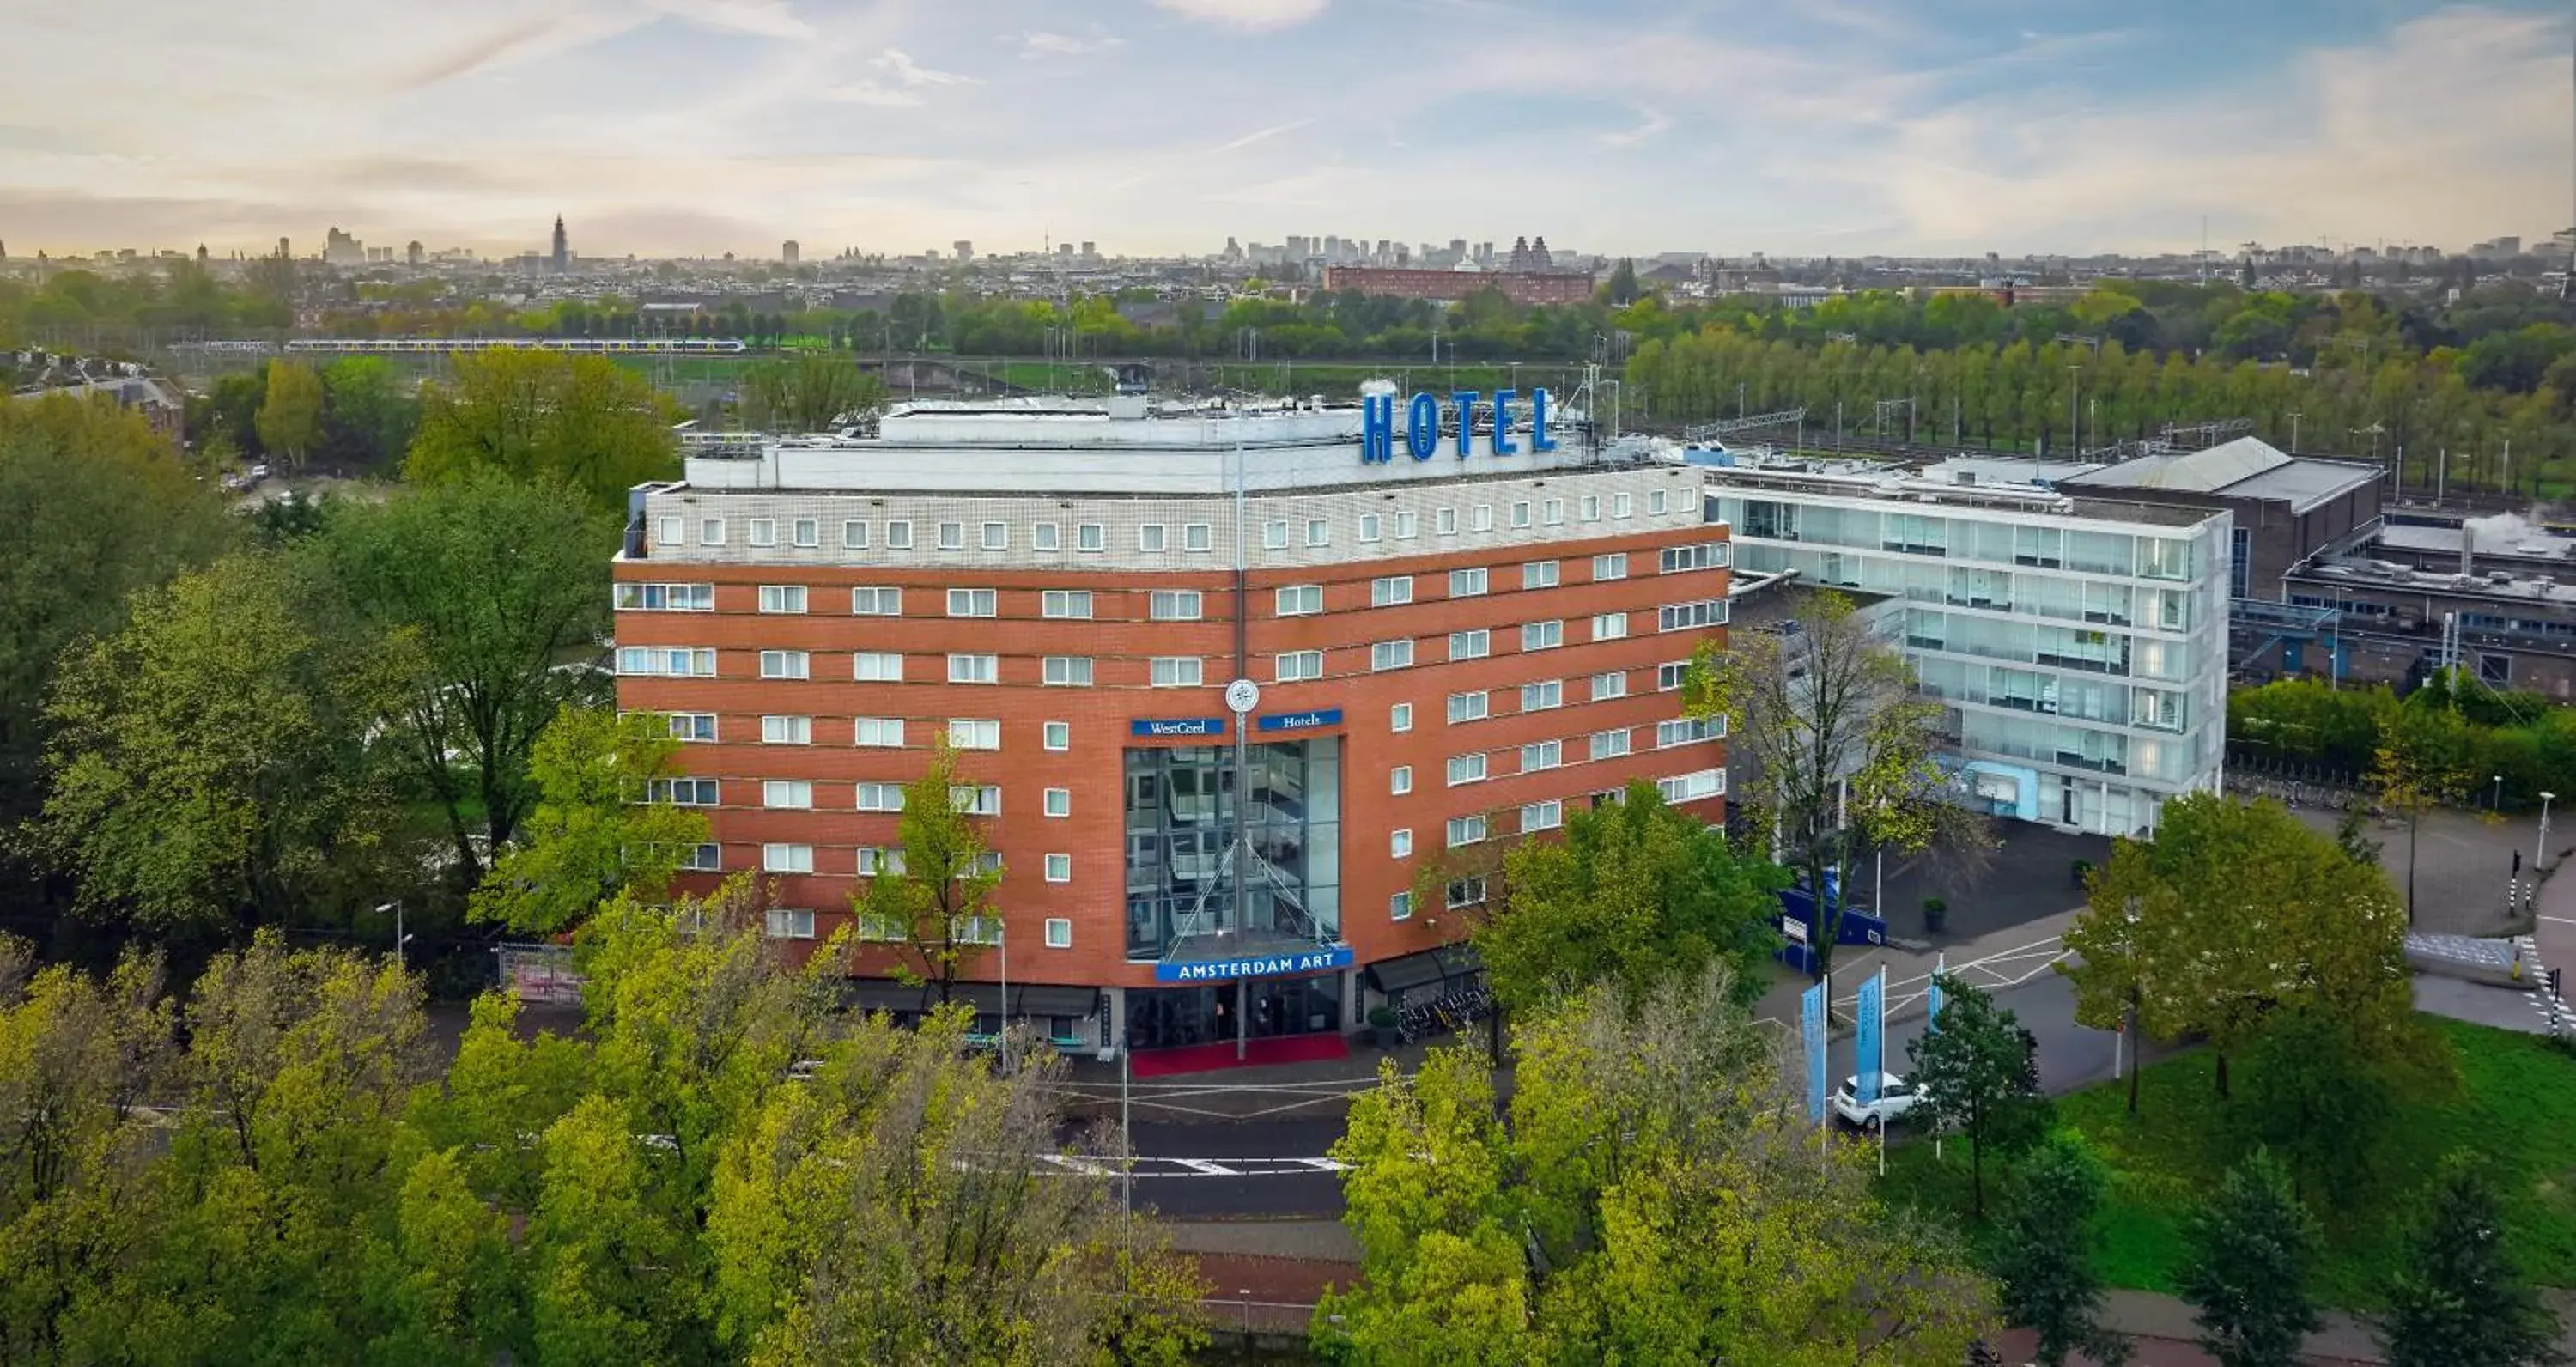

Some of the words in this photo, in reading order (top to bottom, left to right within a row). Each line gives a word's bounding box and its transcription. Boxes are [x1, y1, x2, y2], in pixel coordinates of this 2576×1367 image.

[1363, 387, 1556, 464] HOTEL
[1151, 720, 1205, 734] WestCord
[1284, 714, 1321, 727] Hotels
[1179, 957, 1292, 979] AMSTERDAM
[1300, 953, 1334, 969] ART
